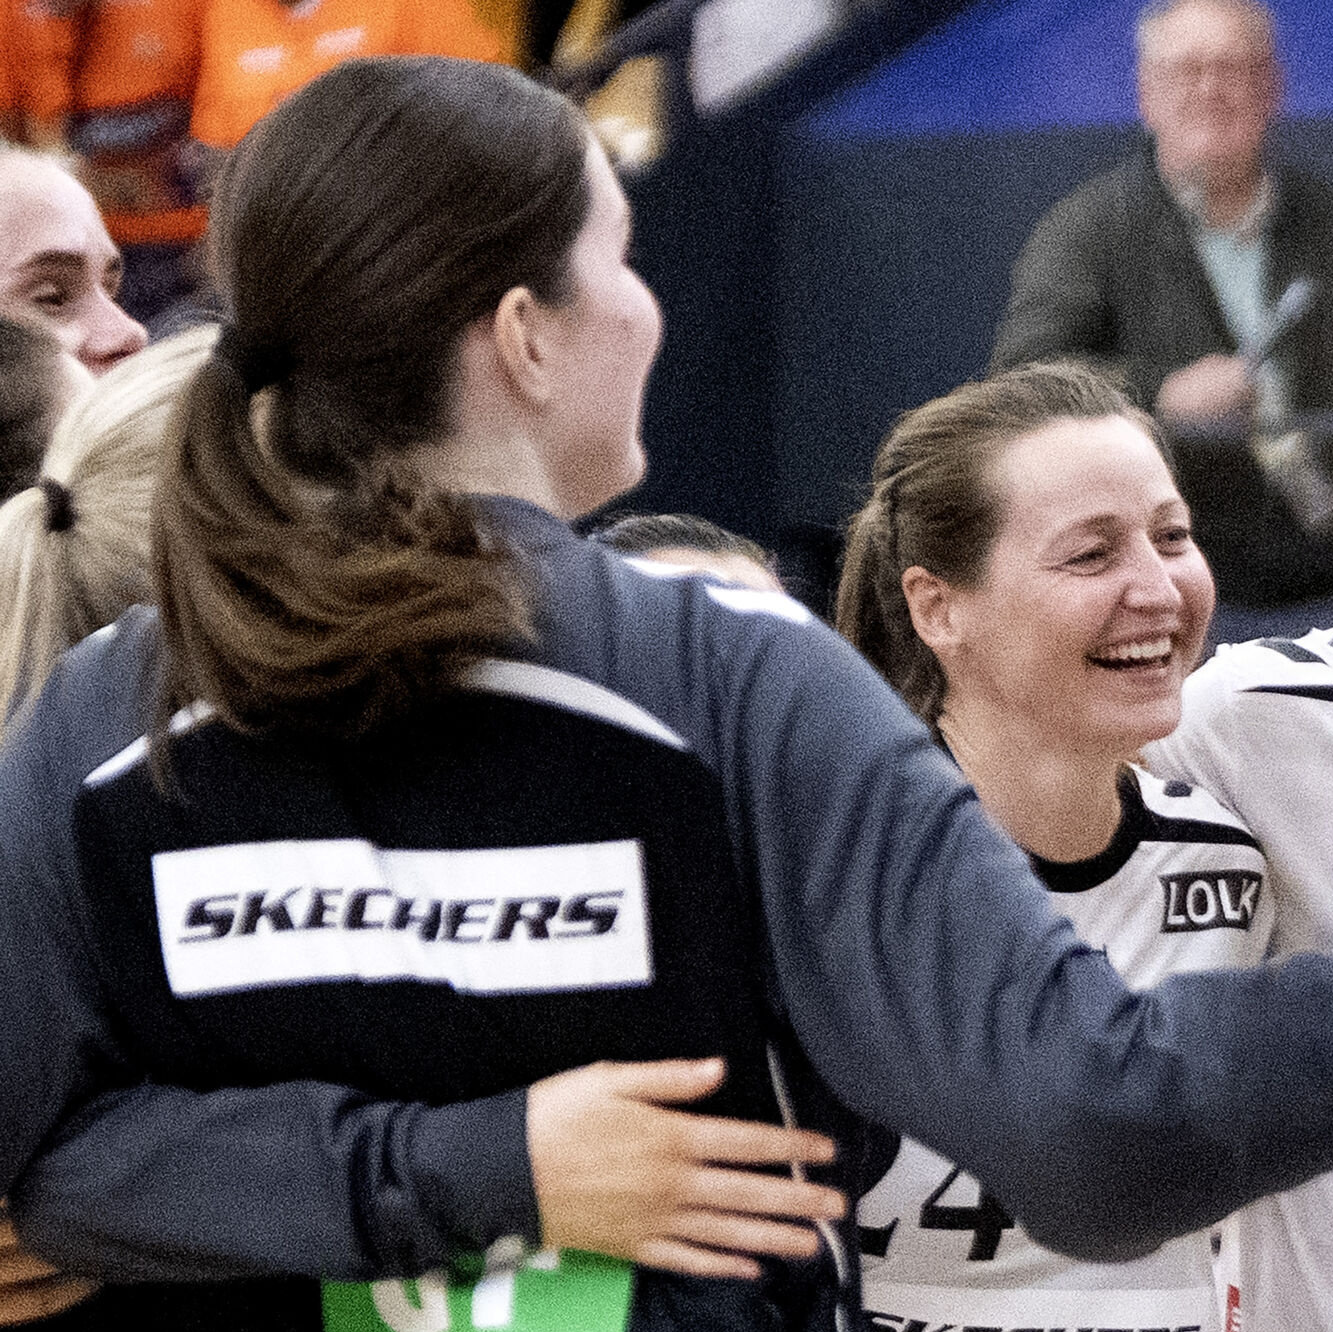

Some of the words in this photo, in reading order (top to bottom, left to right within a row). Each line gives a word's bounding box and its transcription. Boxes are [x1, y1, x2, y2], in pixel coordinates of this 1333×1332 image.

[177, 886, 624, 946] SKECHERS
[1167, 878, 1258, 926] LOLK
[863, 1166, 1014, 1260] 4
